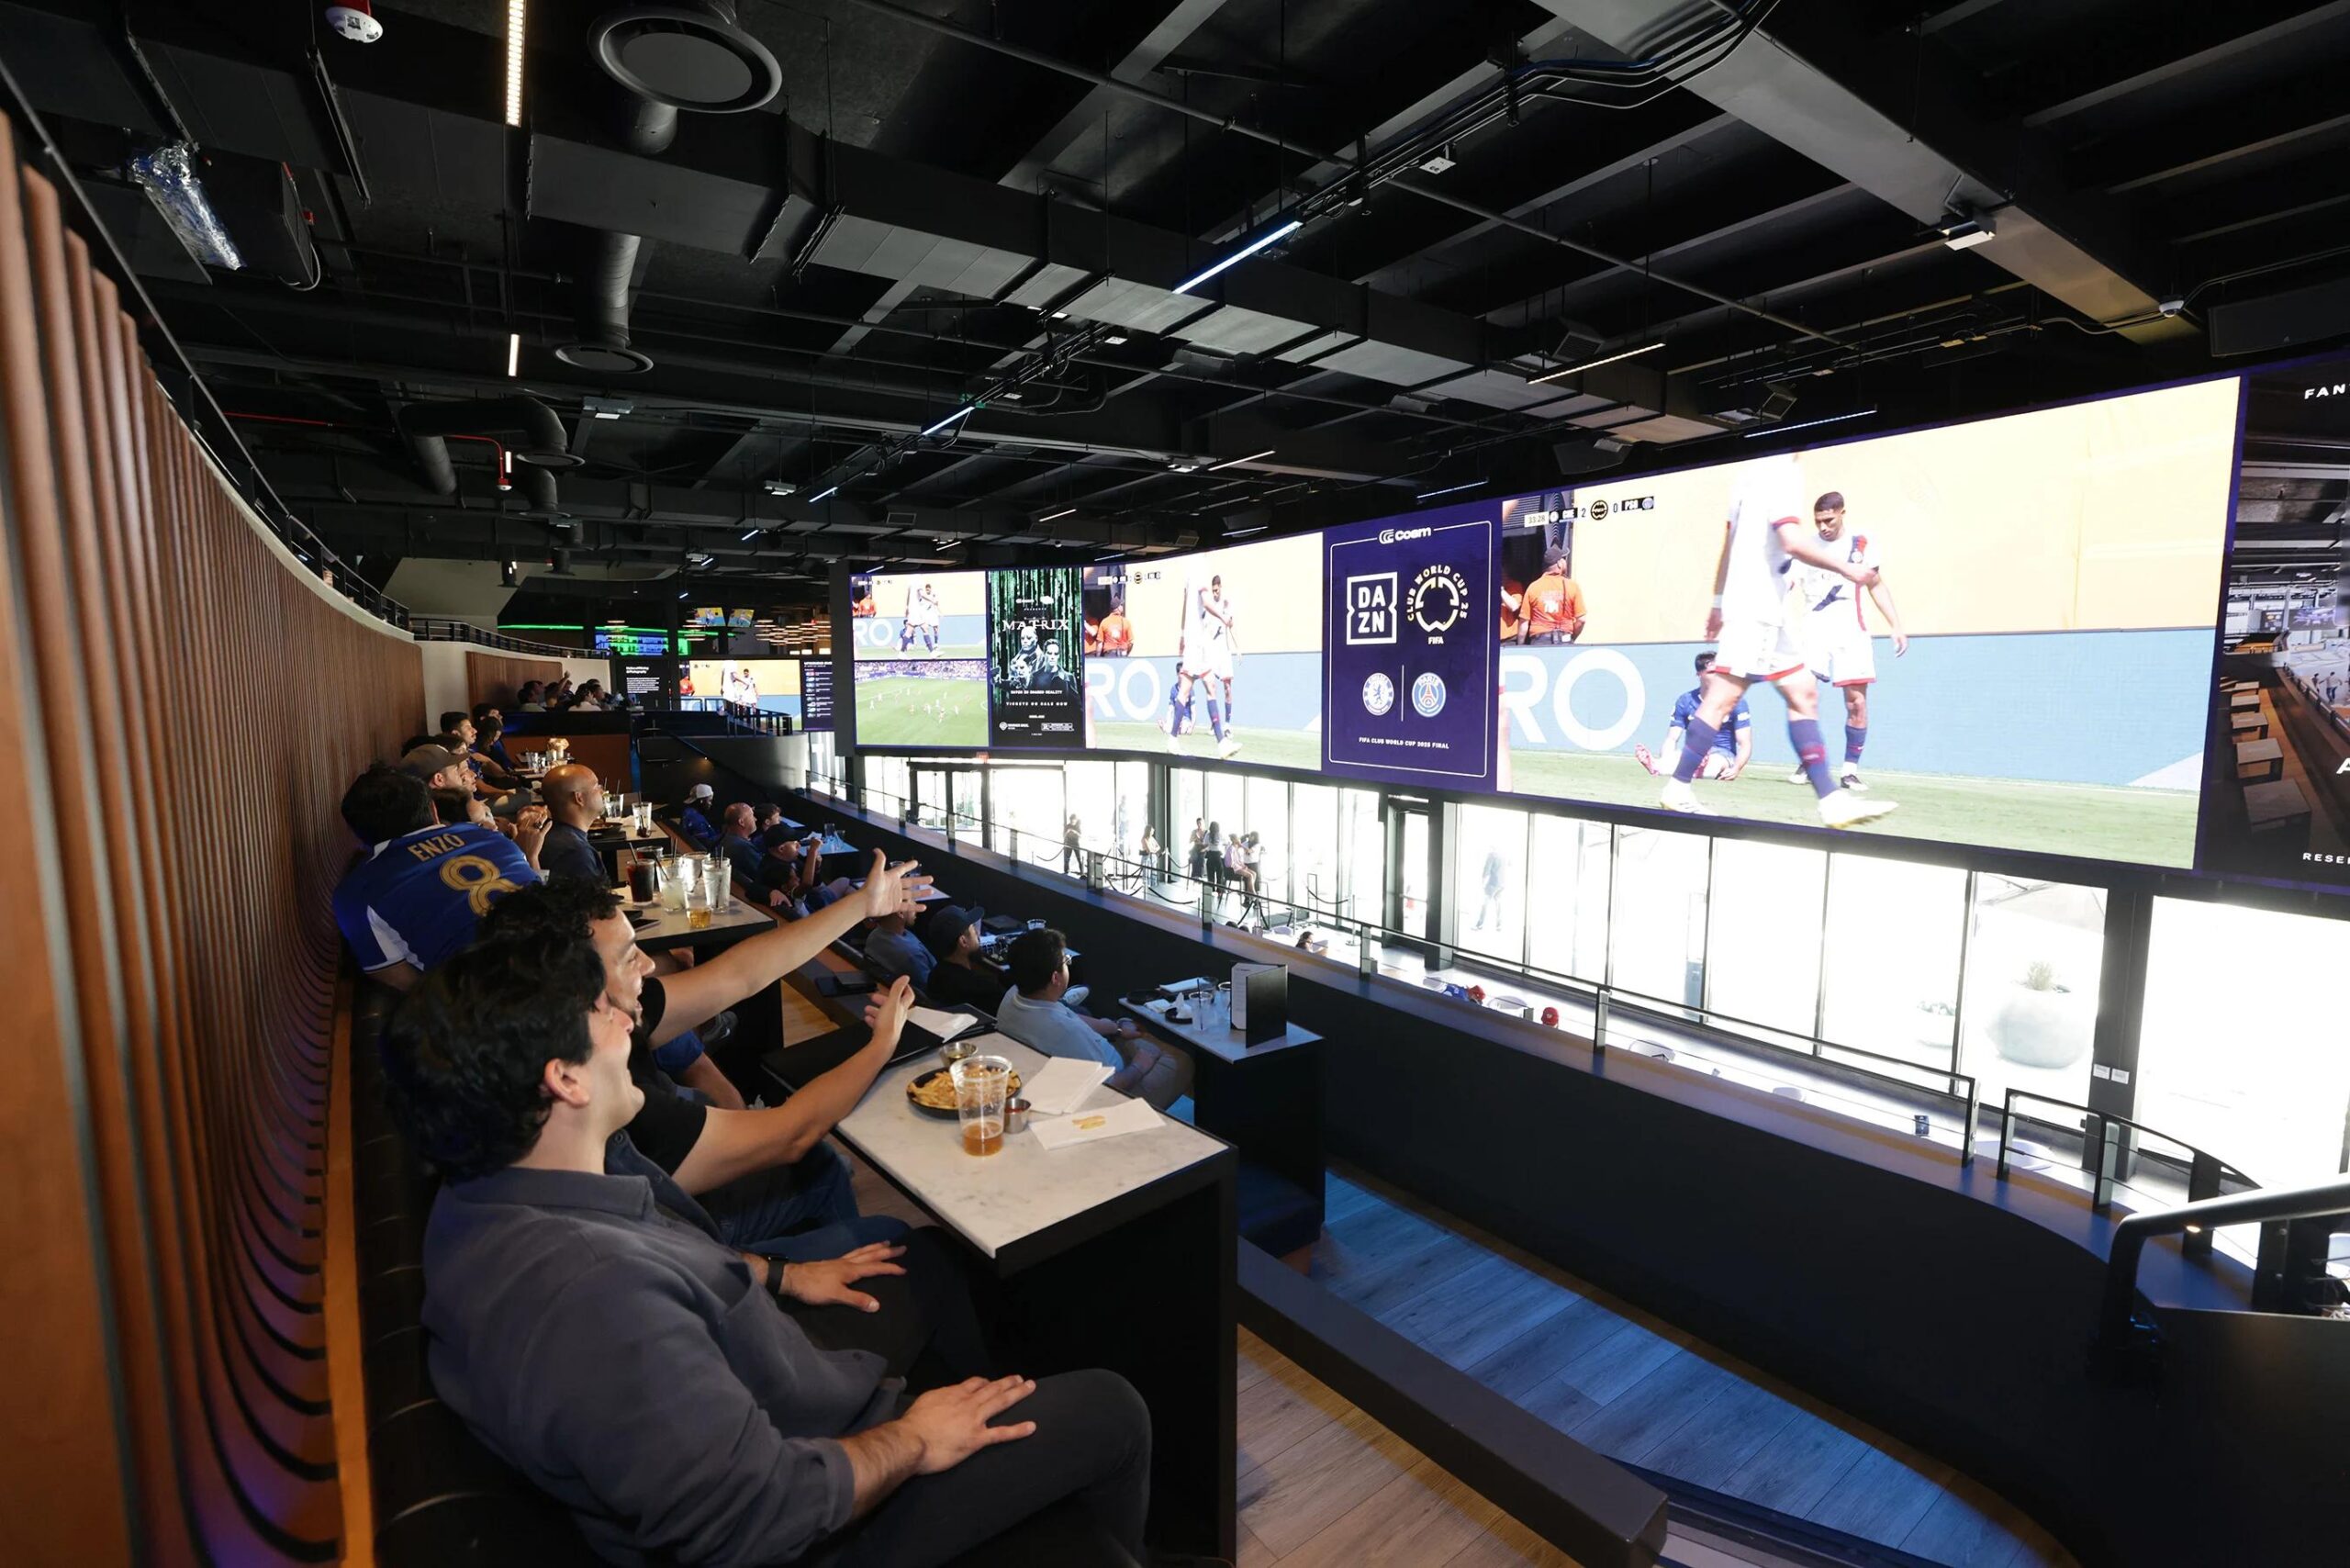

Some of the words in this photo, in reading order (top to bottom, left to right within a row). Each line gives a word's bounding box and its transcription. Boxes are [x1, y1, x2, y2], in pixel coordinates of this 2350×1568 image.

[2304, 384, 2350, 399] FAN
[1582, 508, 1587, 518] 2
[1613, 502, 1618, 513] 0
[1415, 565, 1450, 585] WORLD
[1452, 573, 1469, 596] CUP
[1406, 588, 1416, 622] CLUB
[1460, 602, 1469, 619] 25
[1002, 619, 1069, 632] MATRIX
[1427, 636, 1445, 644] FIFA
[1499, 648, 1646, 751] RO
[408, 834, 465, 862] ENZO
[2302, 852, 2350, 865] RESE
[439, 855, 524, 917] 8
